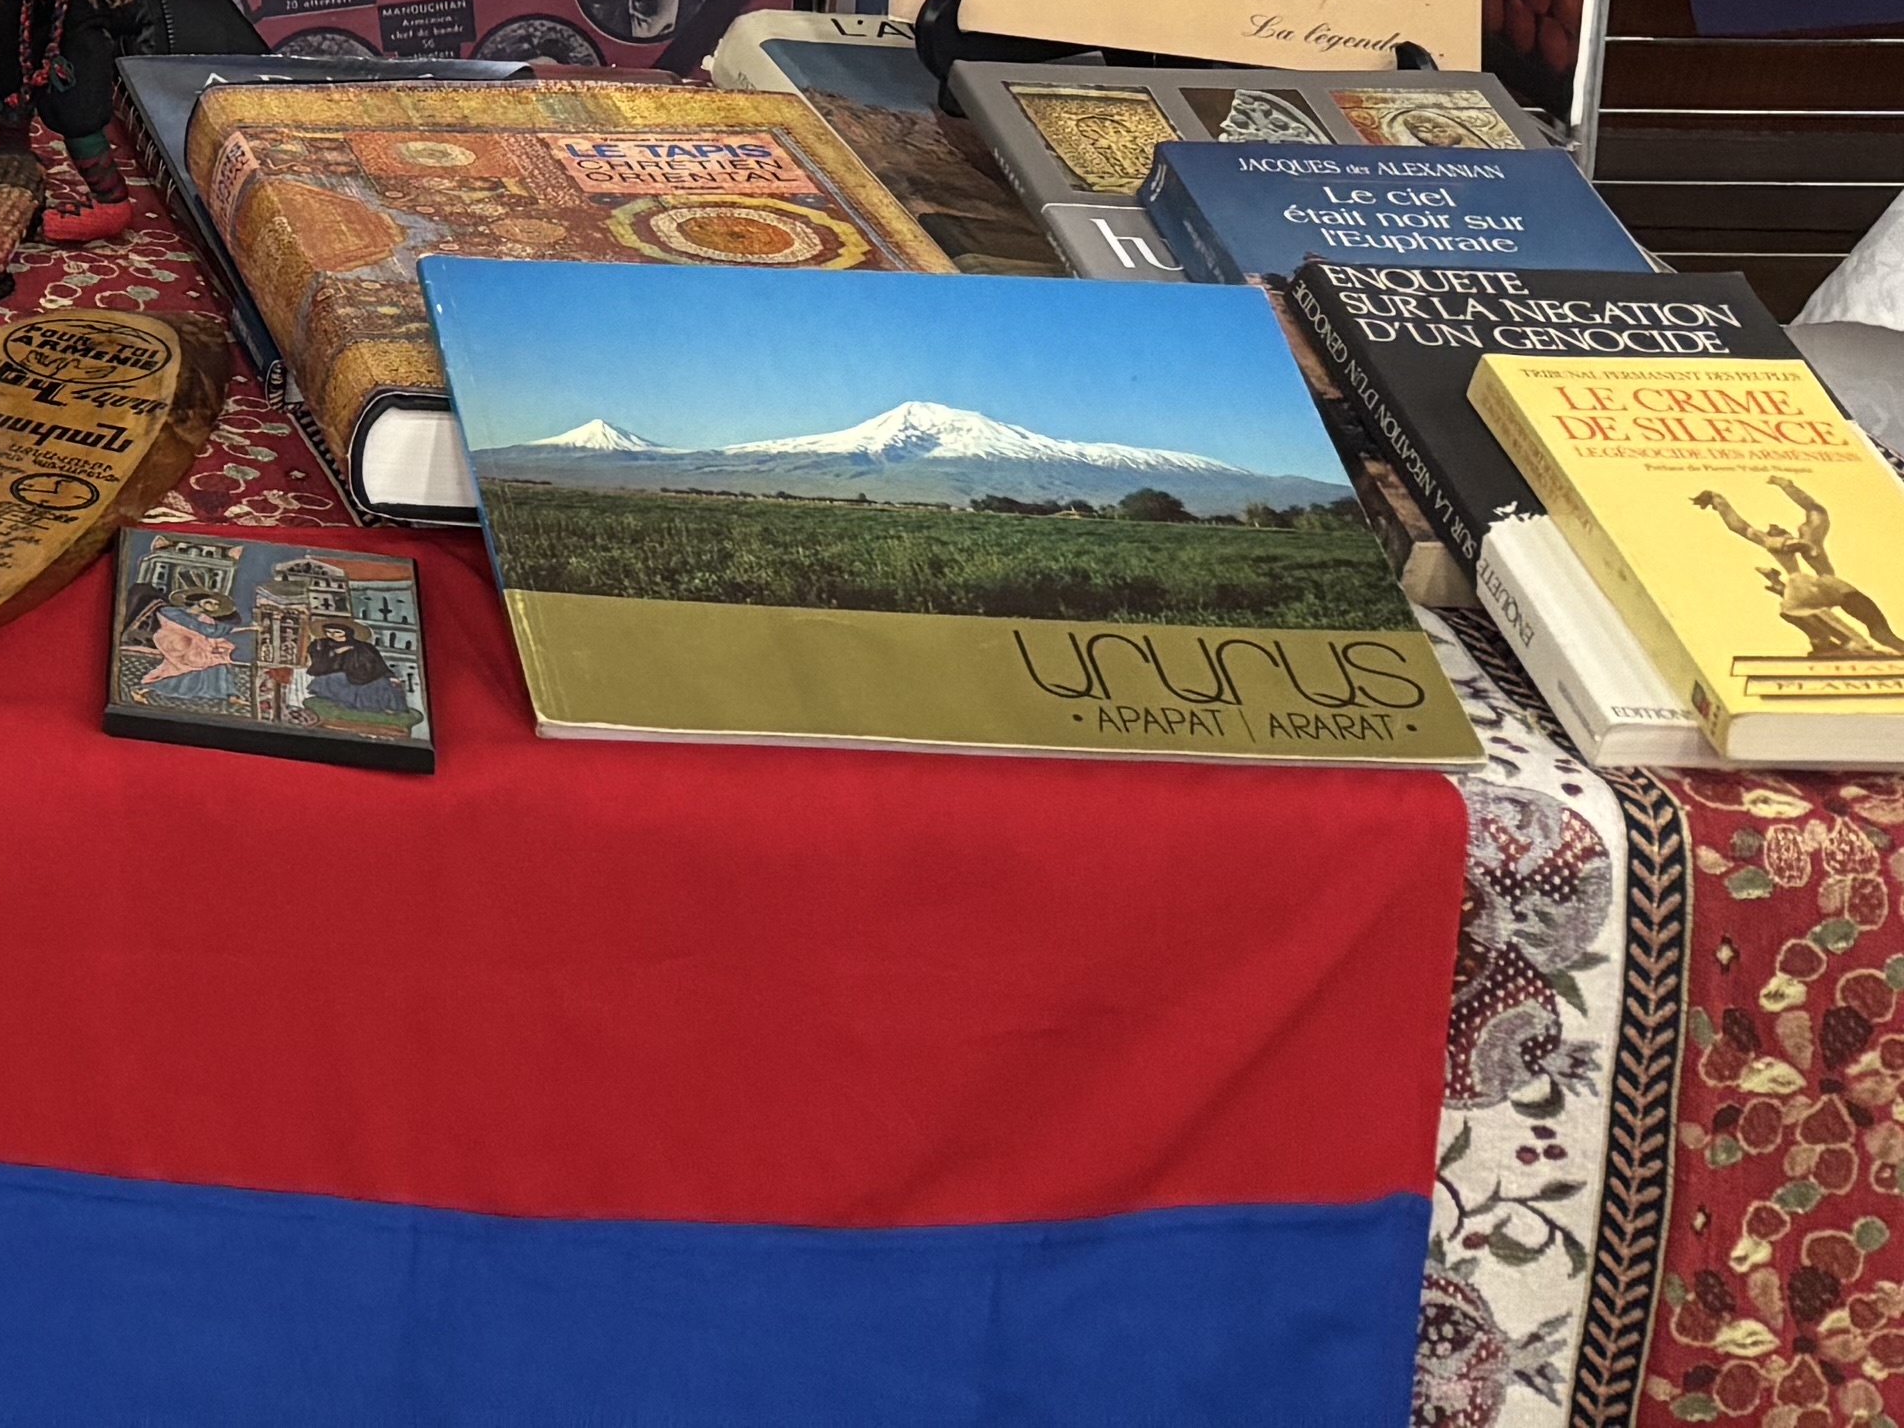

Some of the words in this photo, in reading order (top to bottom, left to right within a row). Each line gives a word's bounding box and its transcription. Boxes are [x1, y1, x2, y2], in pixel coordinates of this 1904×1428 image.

[1242, 13, 1295, 40] La
[1303, 22, 1401, 53] légend
[565, 142, 626, 159] LE
[641, 143, 773, 159] TAPIS
[584, 171, 798, 184] ORIENTAL
[1238, 157, 1342, 176] JACQUES
[1346, 164, 1371, 176] der
[1378, 161, 1506, 180] ALEXANIAN
[1323, 185, 1377, 206] Le
[1387, 186, 1458, 208] ciel
[1283, 204, 1365, 226] était
[1377, 210, 1450, 230] noir
[1463, 214, 1525, 232] sur
[1322, 227, 1519, 255] l'Euphrate
[1323, 264, 1530, 297] ENQUETE
[1341, 294, 1428, 319] SUR
[1437, 296, 1494, 324] LA
[1498, 298, 1742, 330] NEGATION
[24, 323, 90, 351] POUR
[1355, 317, 1478, 350] D'UN
[1492, 326, 1731, 355] GENOCIDE
[11, 332, 160, 374] ARMENIE
[1554, 385, 1629, 413] LE
[1632, 386, 1806, 418] CRIME
[1551, 413, 1636, 443] DE
[1641, 415, 1852, 448] SILENCE
[1571, 446, 1594, 458] LE
[1710, 447, 1744, 461] DES
[1270, 713, 1393, 742] ARARAT
